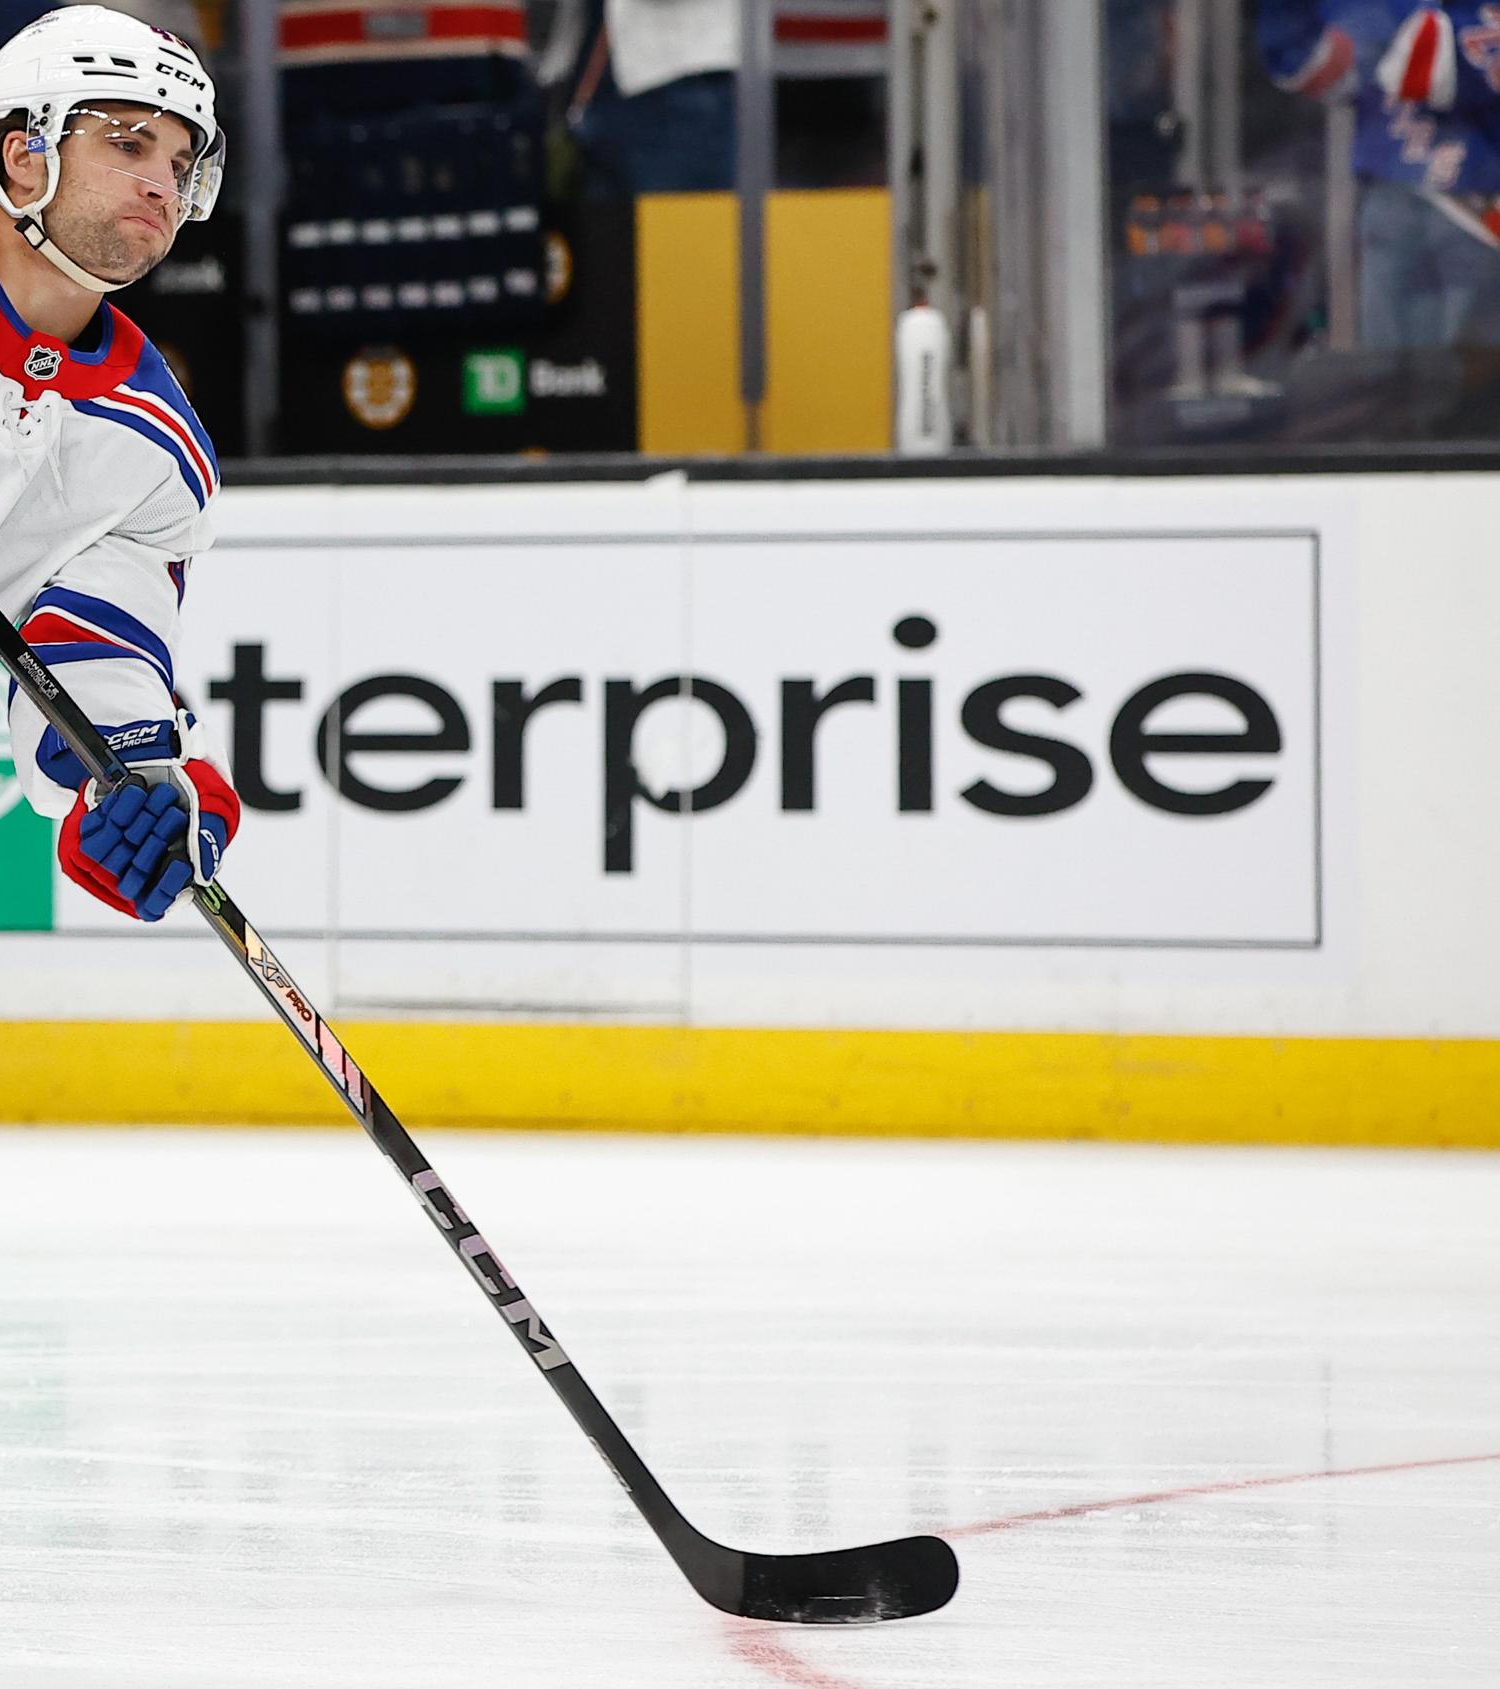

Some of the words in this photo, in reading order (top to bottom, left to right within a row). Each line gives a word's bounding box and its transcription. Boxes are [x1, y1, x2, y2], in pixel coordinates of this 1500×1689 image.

[155, 61, 206, 91] CCM
[31, 358, 54, 371] NHL
[23, 651, 60, 694] NANOLITE
[106, 723, 161, 746] CCM
[121, 738, 142, 749] PRO
[285, 988, 313, 1023] PRO
[411, 1168, 571, 1371] CCM
